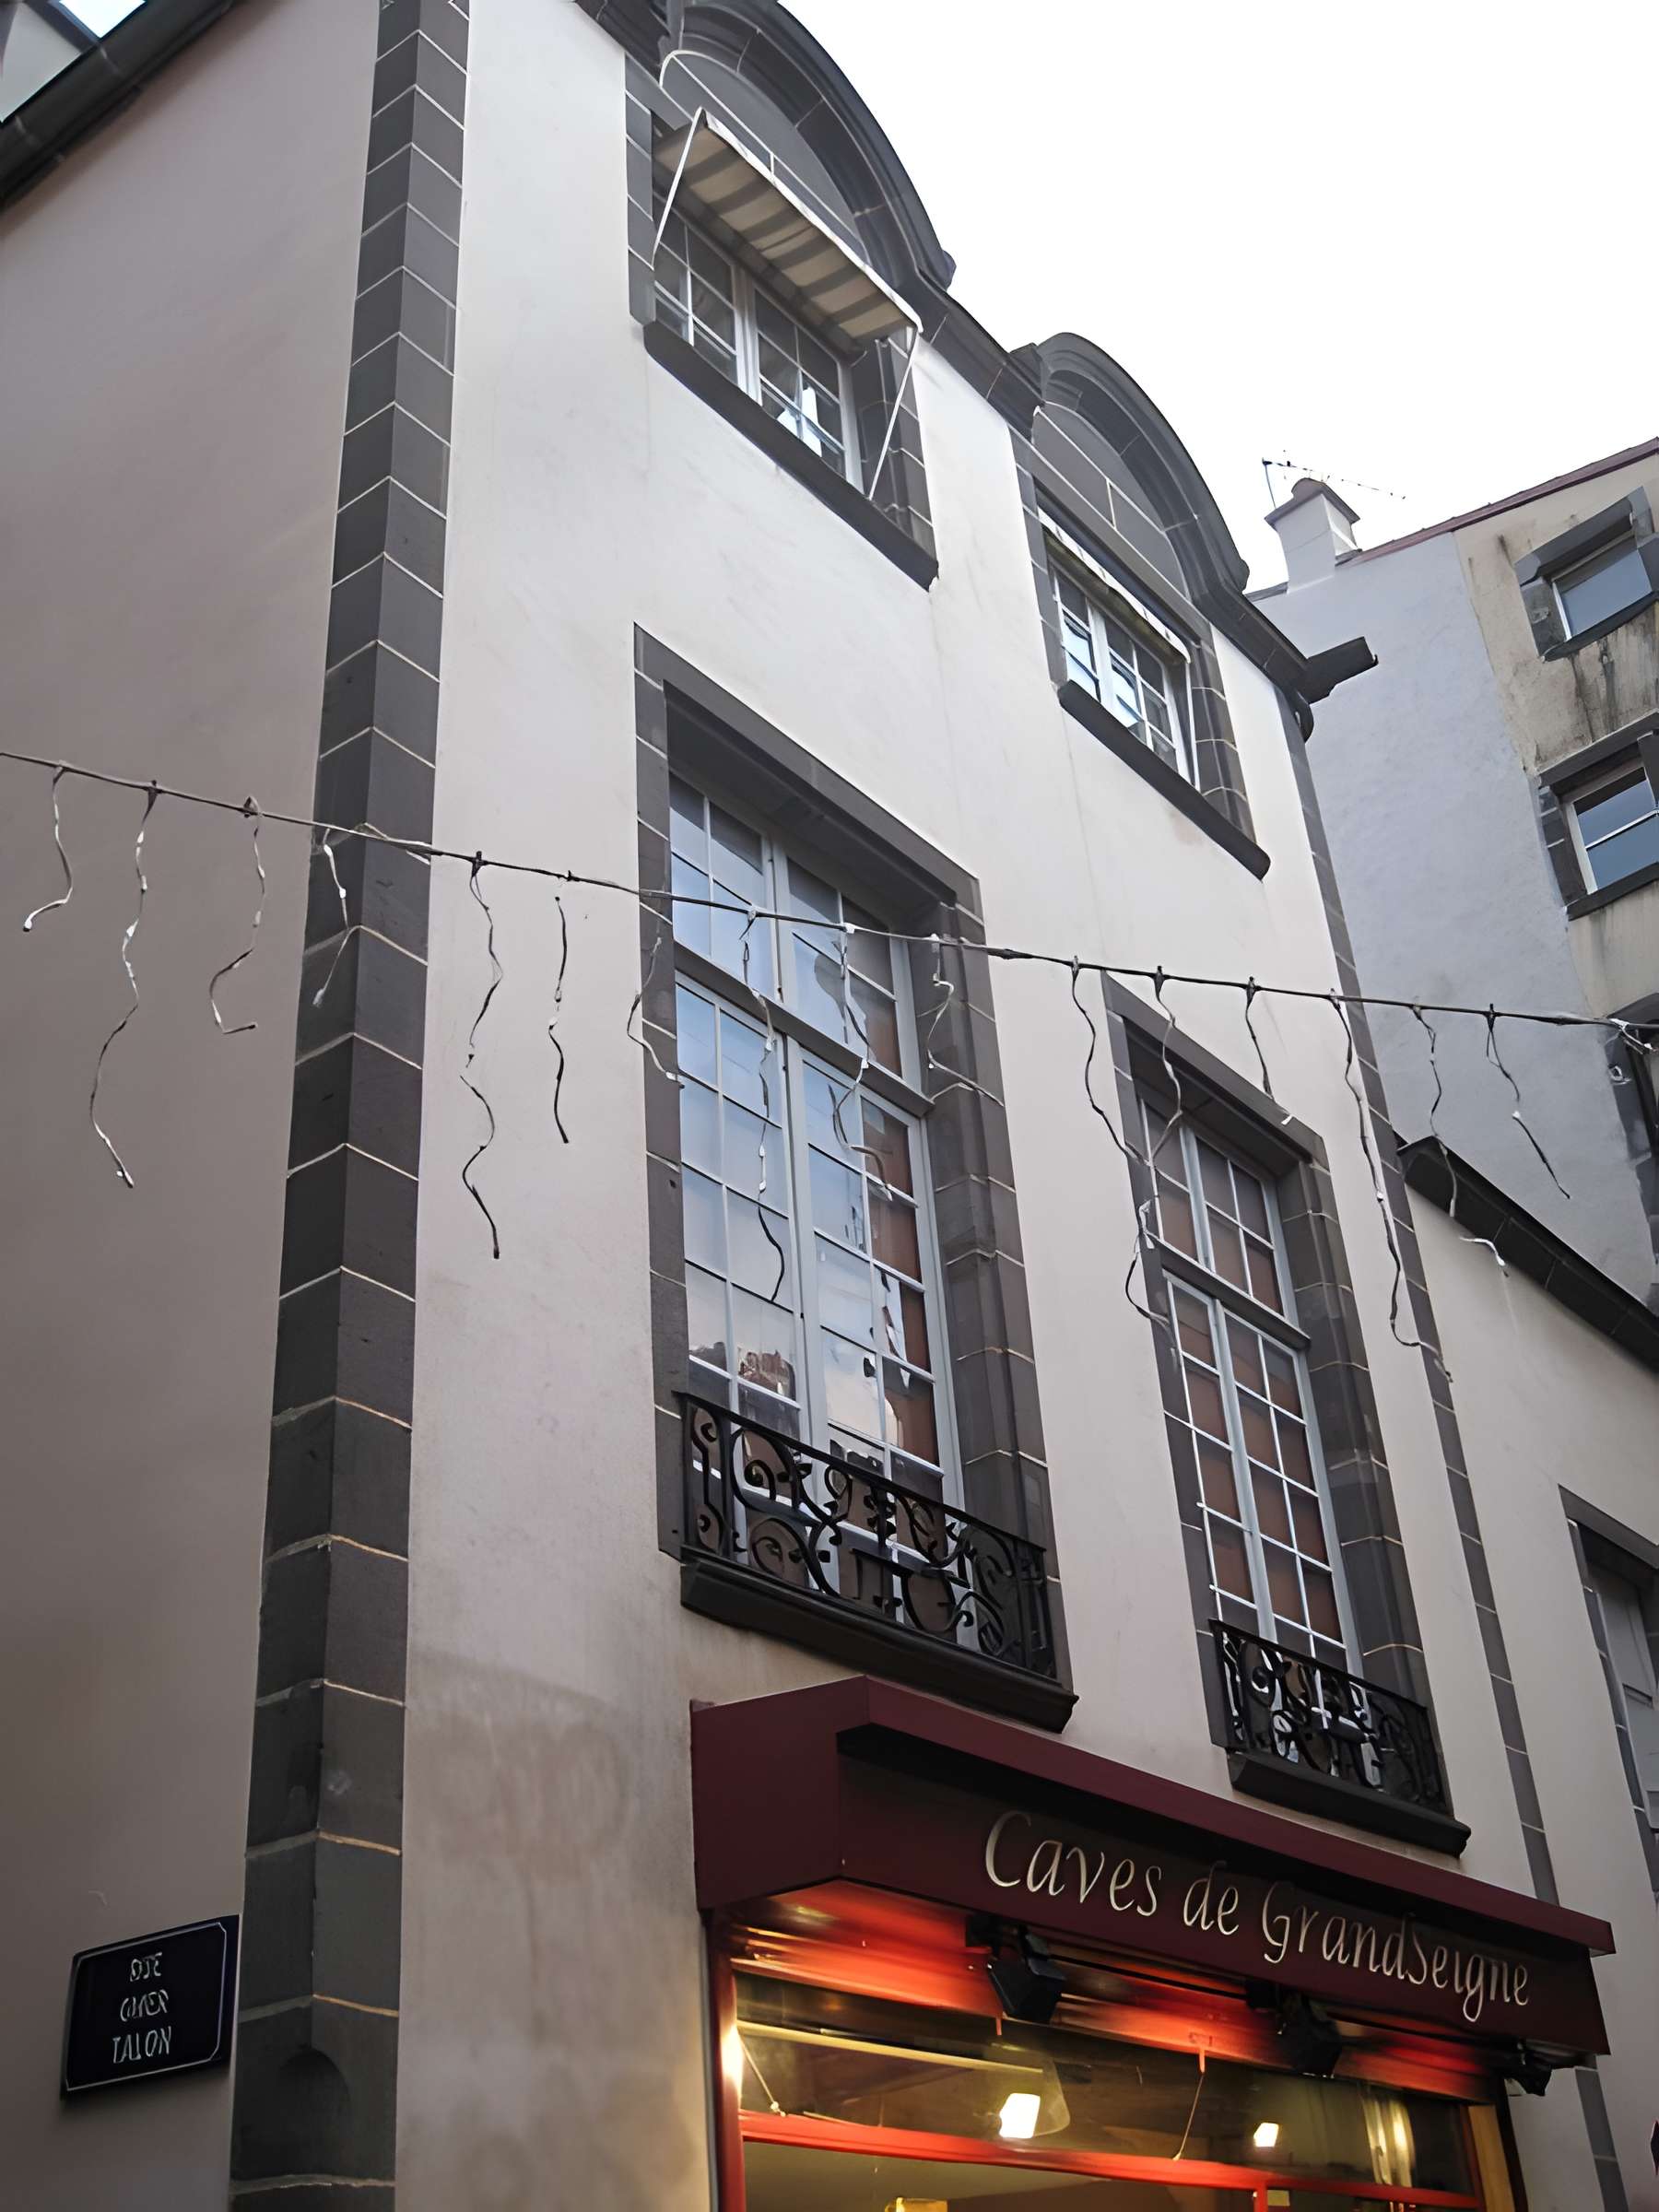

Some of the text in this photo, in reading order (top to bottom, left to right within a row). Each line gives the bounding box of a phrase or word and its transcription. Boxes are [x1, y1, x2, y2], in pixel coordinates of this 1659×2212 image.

[985, 1809, 1162, 1917] Caves
[1182, 1859, 1240, 1936] de
[112, 2026, 172, 2064] TALON
